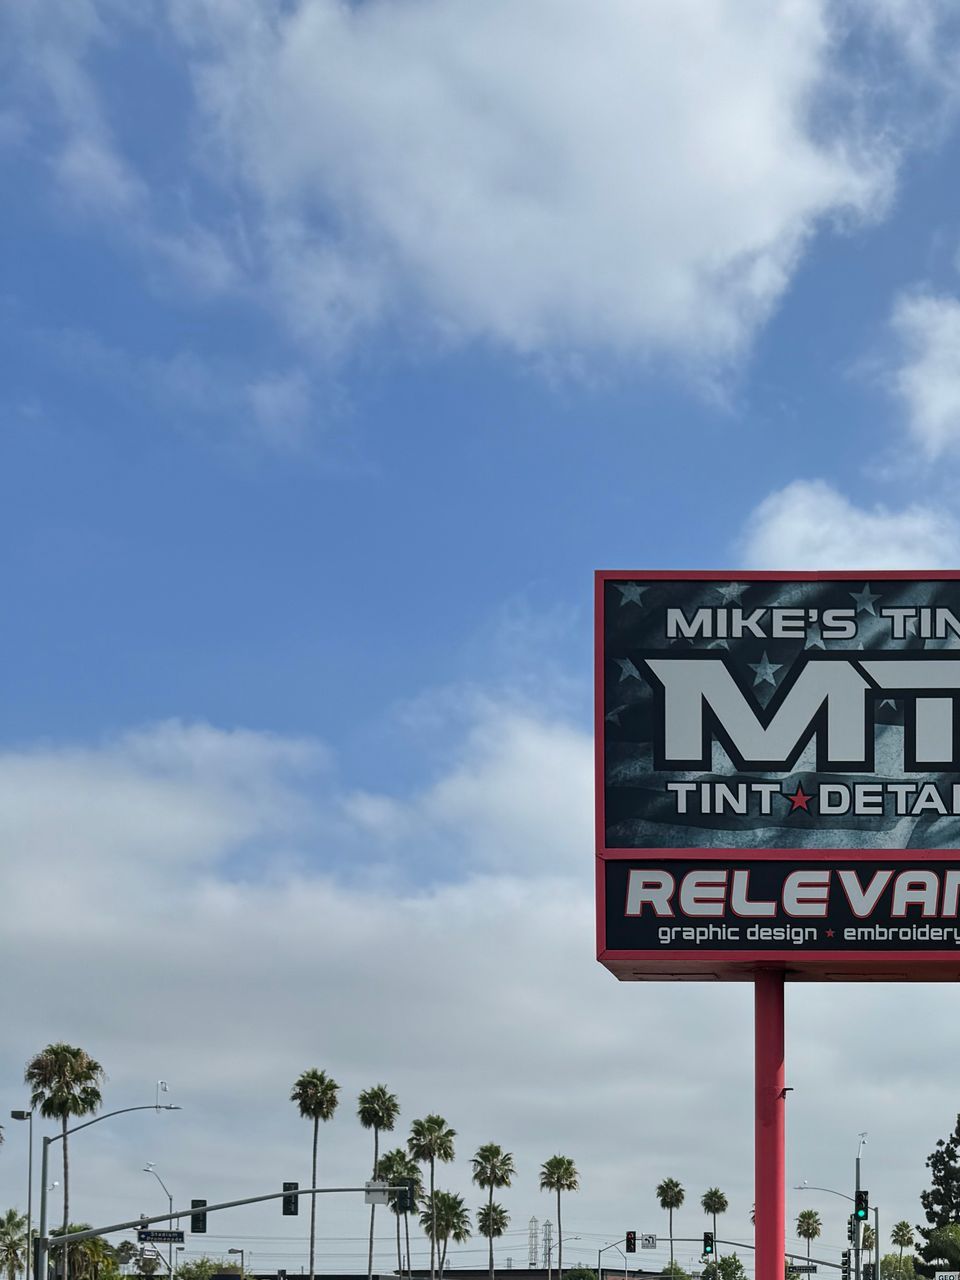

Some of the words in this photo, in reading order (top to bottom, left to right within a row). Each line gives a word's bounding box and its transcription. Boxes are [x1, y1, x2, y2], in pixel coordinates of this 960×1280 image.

[666, 607, 857, 639] MIKE'S
[667, 783, 782, 814] TINT
[658, 924, 740, 943] graphic
[746, 924, 818, 944] design
